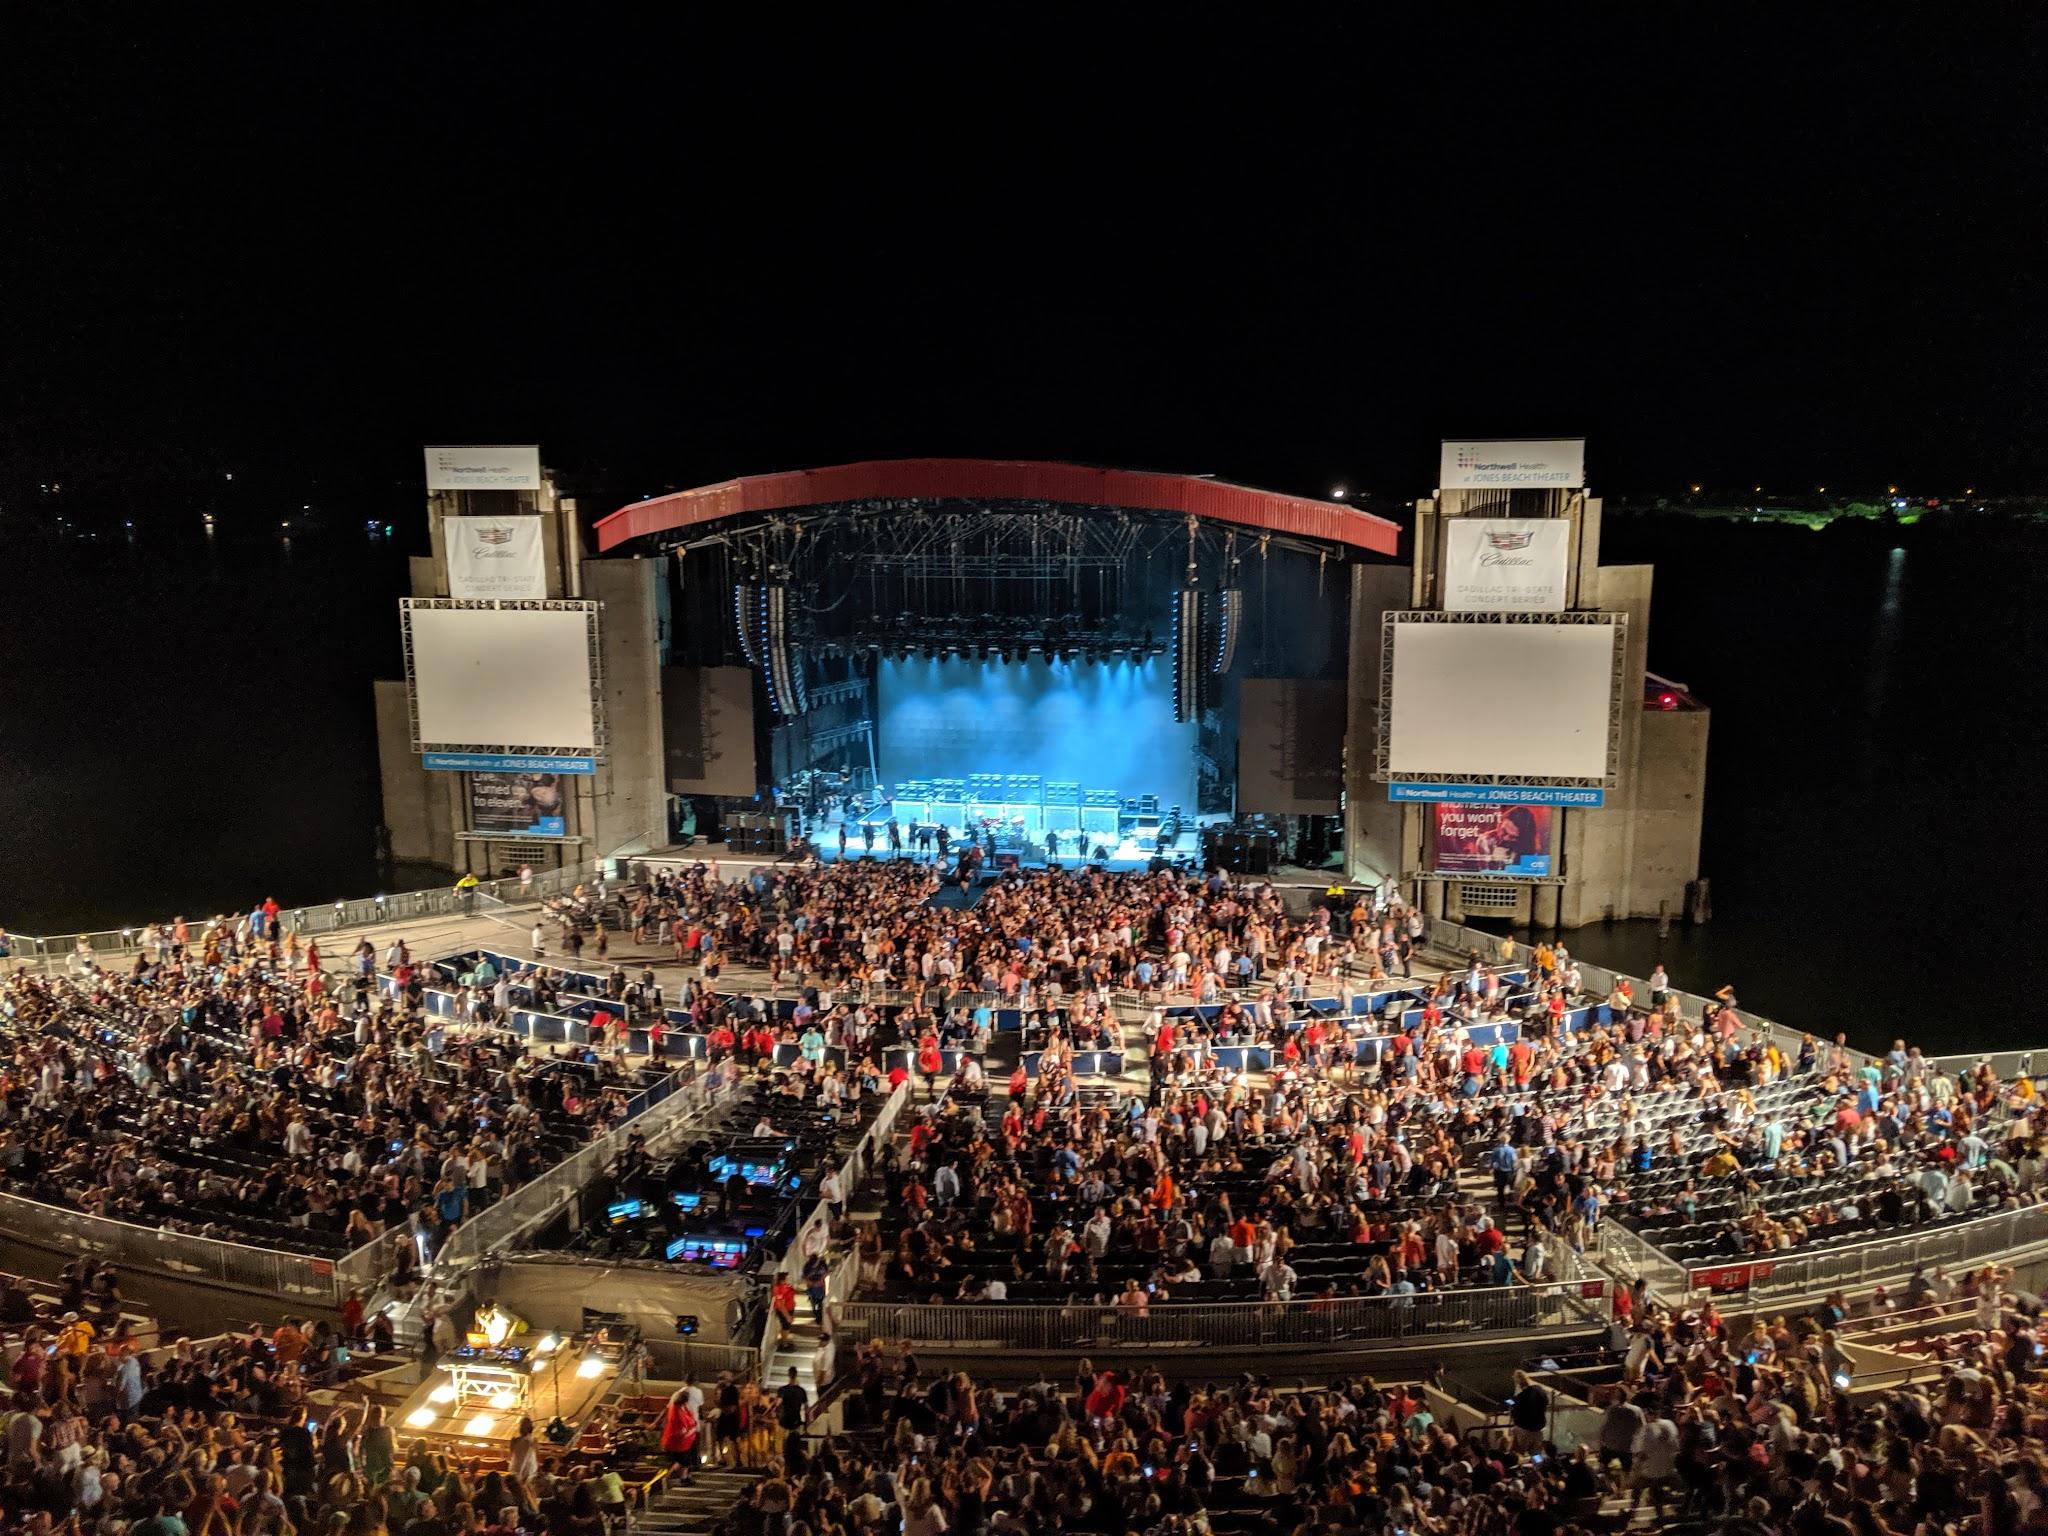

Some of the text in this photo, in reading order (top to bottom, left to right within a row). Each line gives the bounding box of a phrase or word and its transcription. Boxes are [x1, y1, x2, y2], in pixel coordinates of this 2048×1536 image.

[1474, 462, 1517, 471] Northwell
[1473, 473, 1501, 482] JONES
[1502, 473, 1530, 482] BEACH
[1531, 472, 1569, 481] THEATER
[1480, 552, 1534, 568] Cadillac
[1457, 585, 1503, 594] CADILLAC
[1512, 595, 1546, 604] SERIES
[555, 761, 589, 770] THEATER
[473, 783, 510, 795] Turned
[1406, 789, 1447, 797] Northwell
[1488, 790, 1519, 800] JONES
[1520, 791, 1553, 801] BEACH
[1555, 792, 1598, 802] THEATER
[474, 796, 486, 807] to
[1441, 812, 1502, 824] you won't
[1720, 1271, 1741, 1285] PIT
